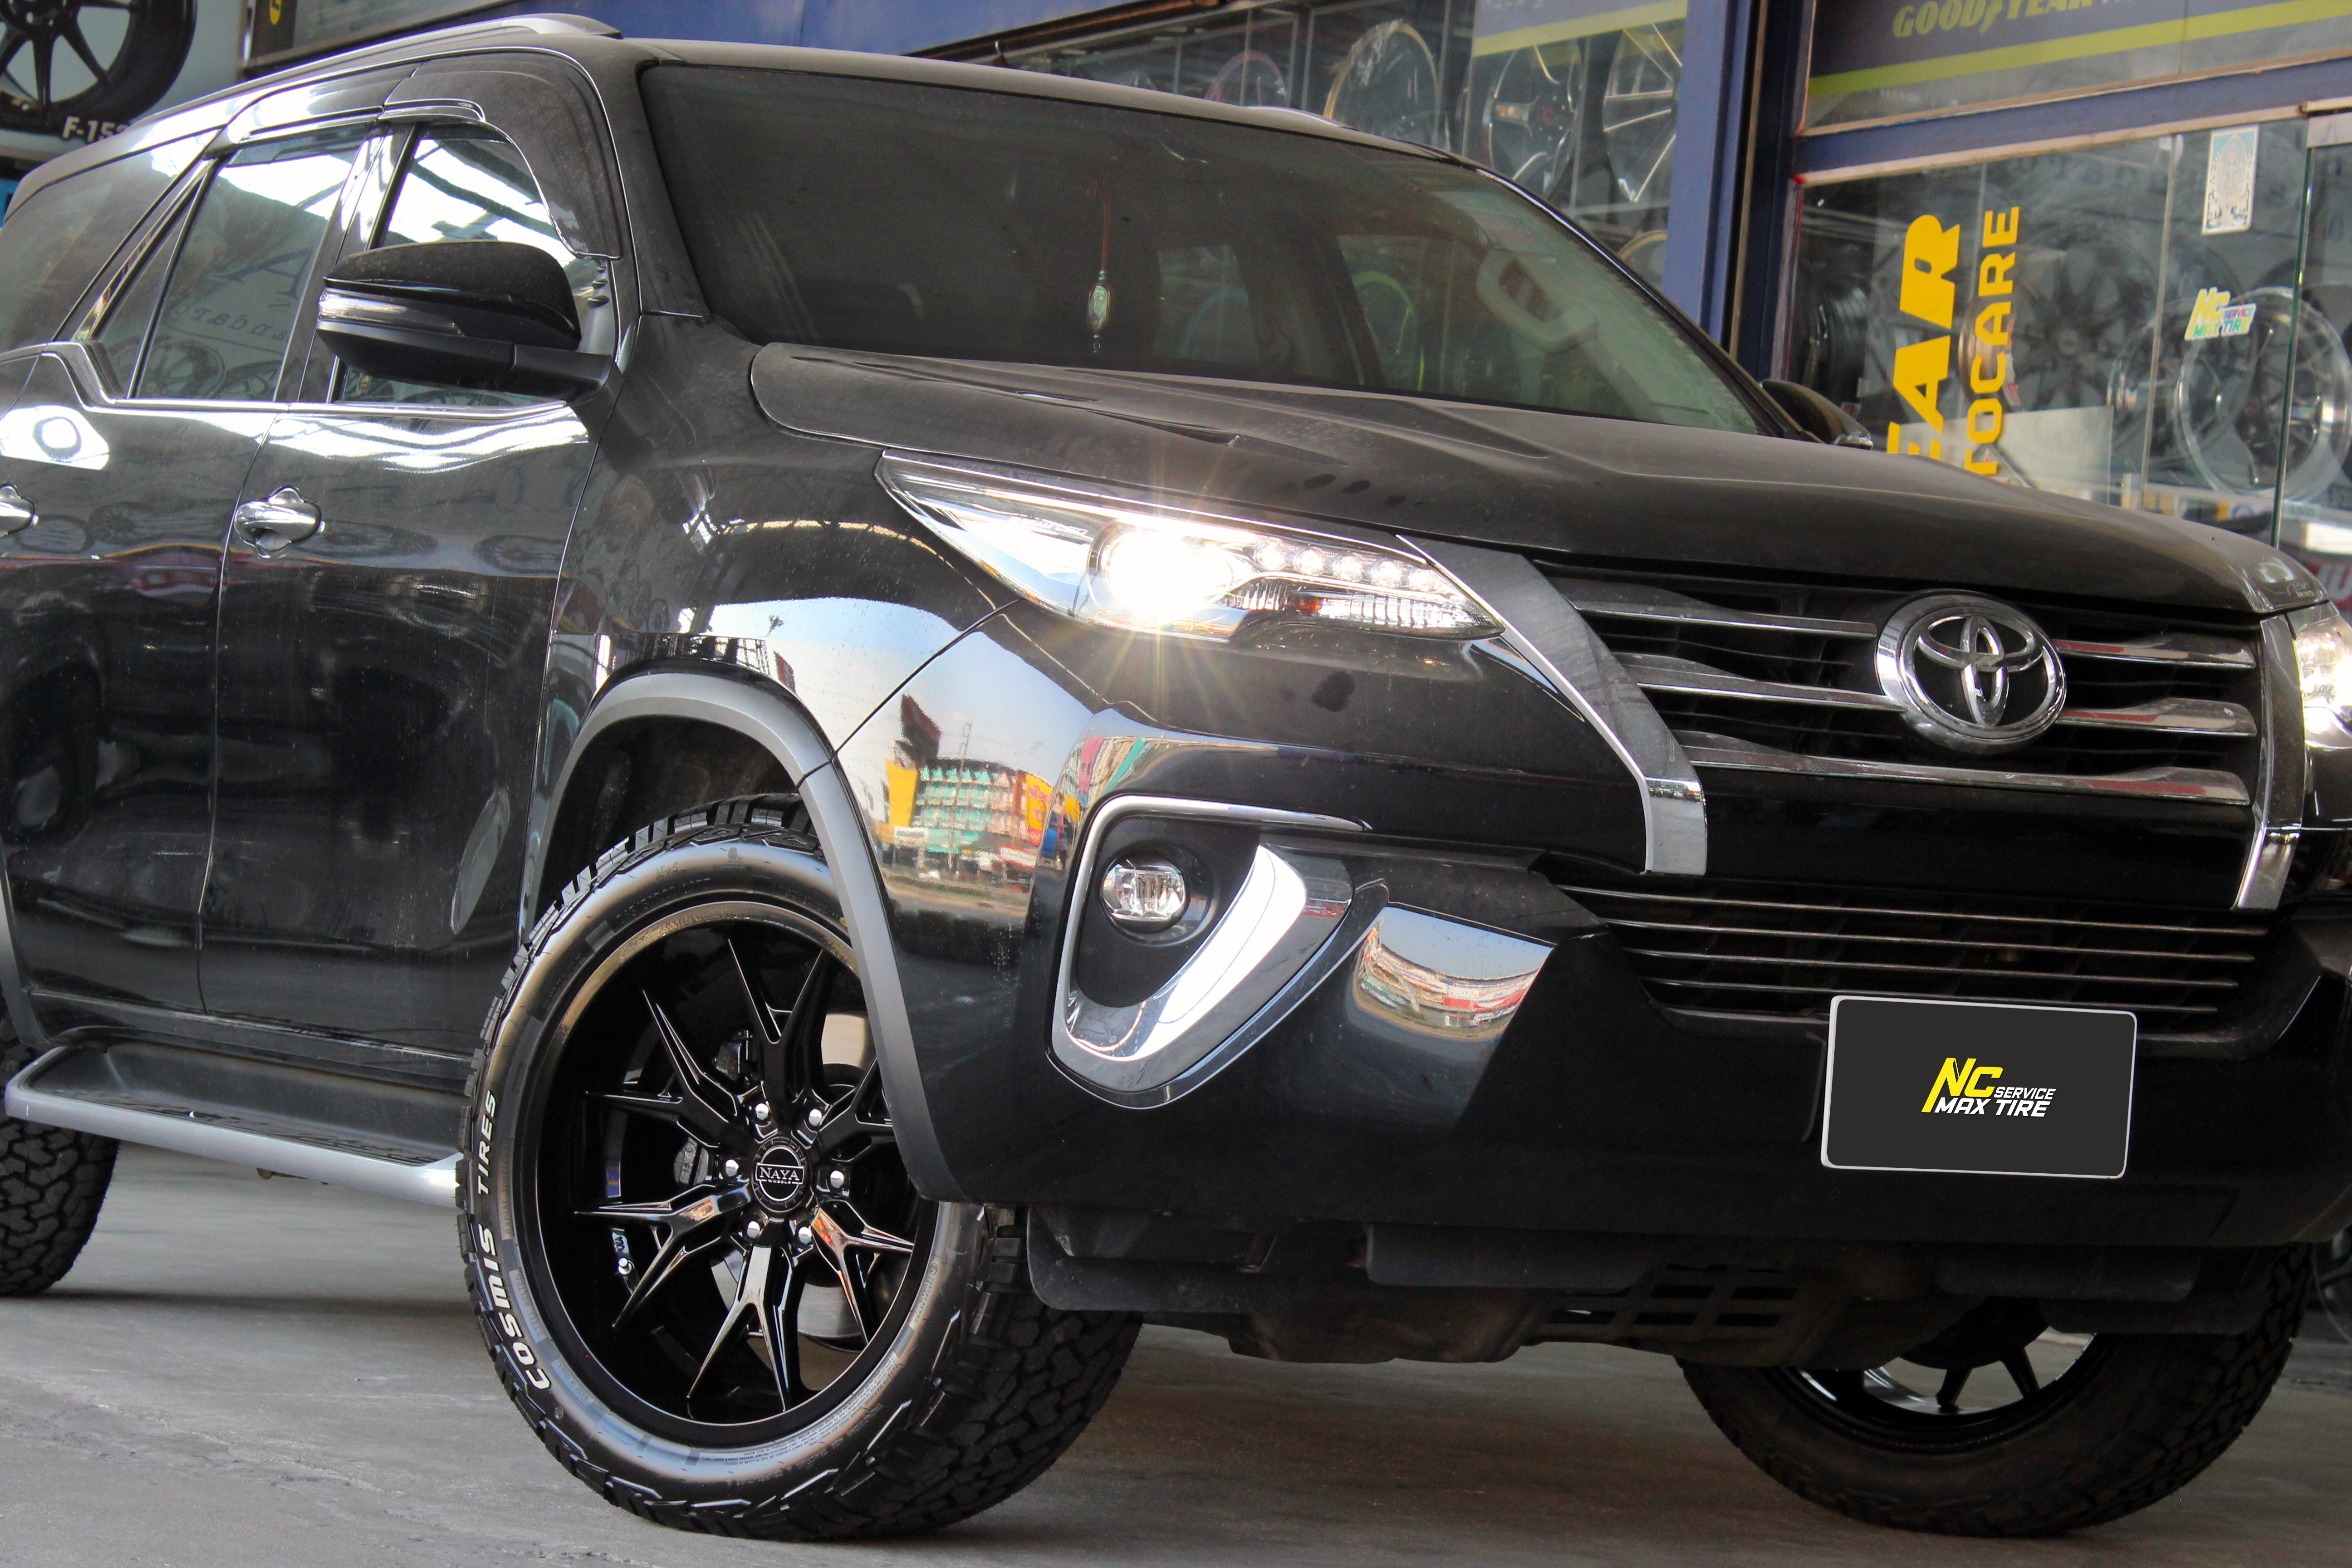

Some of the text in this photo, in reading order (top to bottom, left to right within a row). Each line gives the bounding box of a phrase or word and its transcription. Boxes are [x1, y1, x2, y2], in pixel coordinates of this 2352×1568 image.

[1893, 0, 2092, 38] GOODY
[2186, 288, 2229, 337] NC
[2223, 317, 2251, 333] TIRE
[759, 1167, 800, 1181] NAYA
[478, 1090, 550, 1390] COSMIS TIRES
[528, 1314, 543, 1337] STEEL
